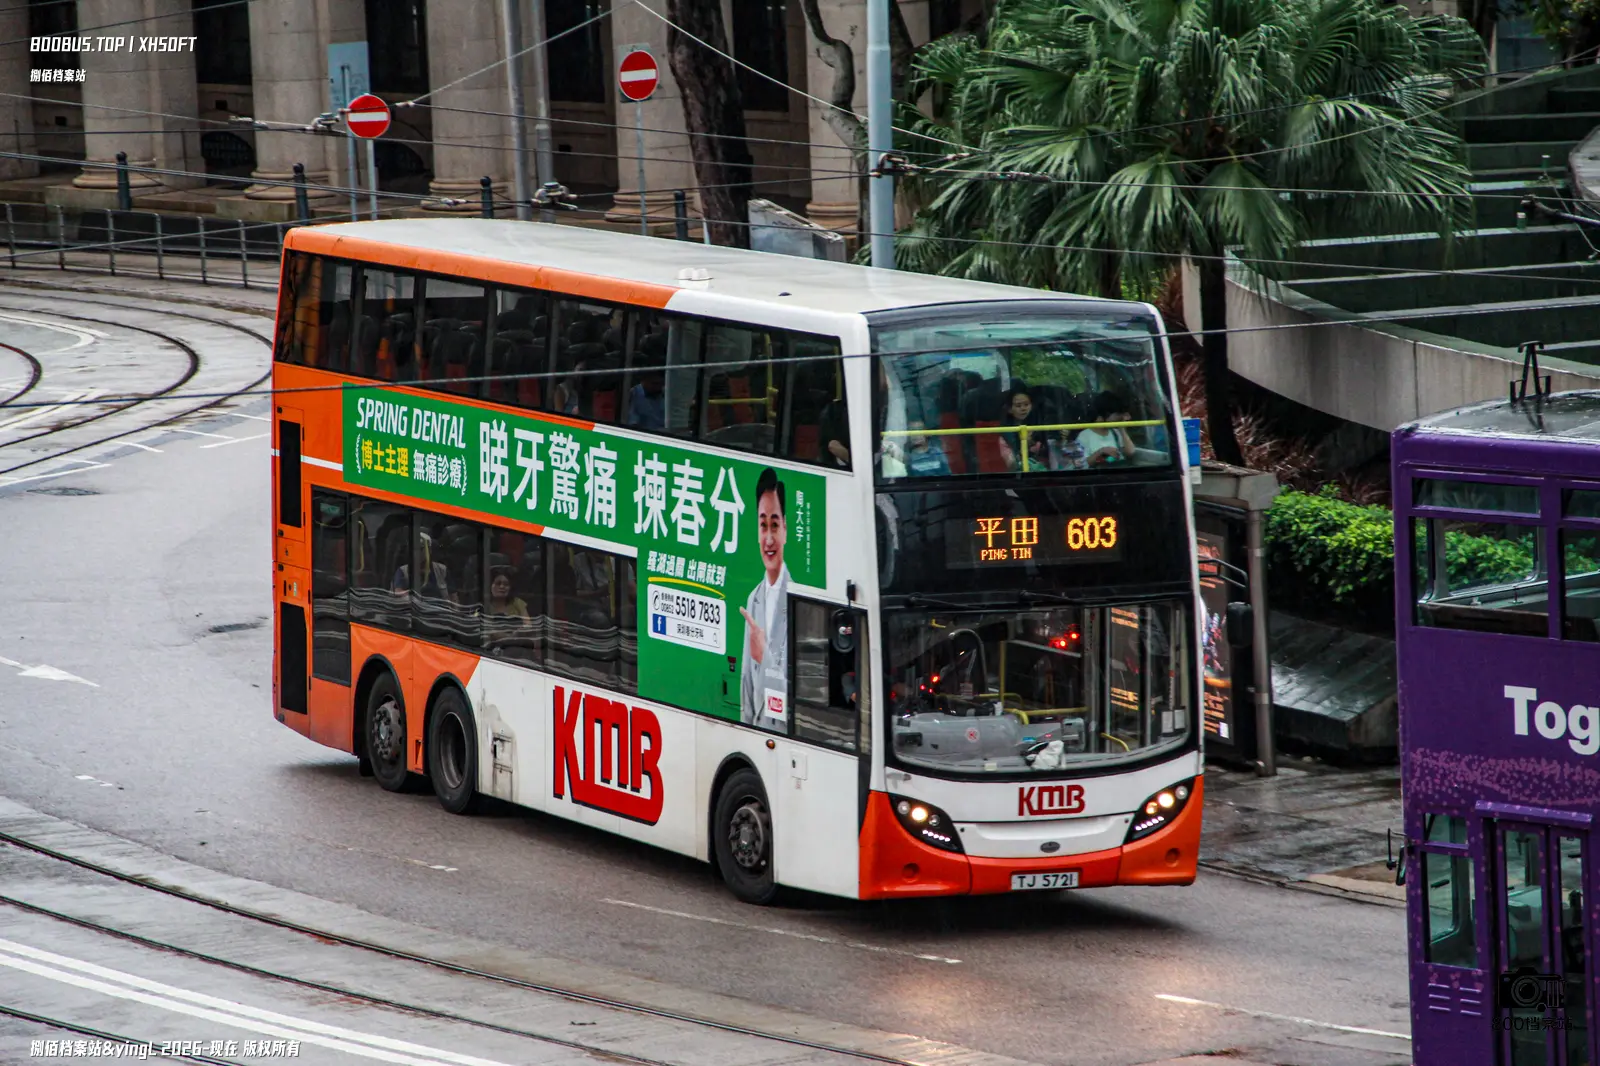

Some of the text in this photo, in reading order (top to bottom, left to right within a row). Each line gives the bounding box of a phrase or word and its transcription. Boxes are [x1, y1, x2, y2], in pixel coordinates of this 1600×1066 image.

[356, 397, 466, 449] SPRING DENTAL
[361, 438, 462, 489] 博士主理 無痛診療
[479, 418, 618, 529] 睇牙驚痛
[633, 450, 746, 554] 揀春分
[974, 516, 1117, 550] 平田 603
[981, 548, 1032, 561] PING TIN
[675, 596, 720, 625] 5518 7833
[1504, 685, 1600, 755] Tog
[553, 685, 664, 827] KMB
[1018, 784, 1086, 817] KMB
[1017, 874, 1073, 888] TJ 5721
